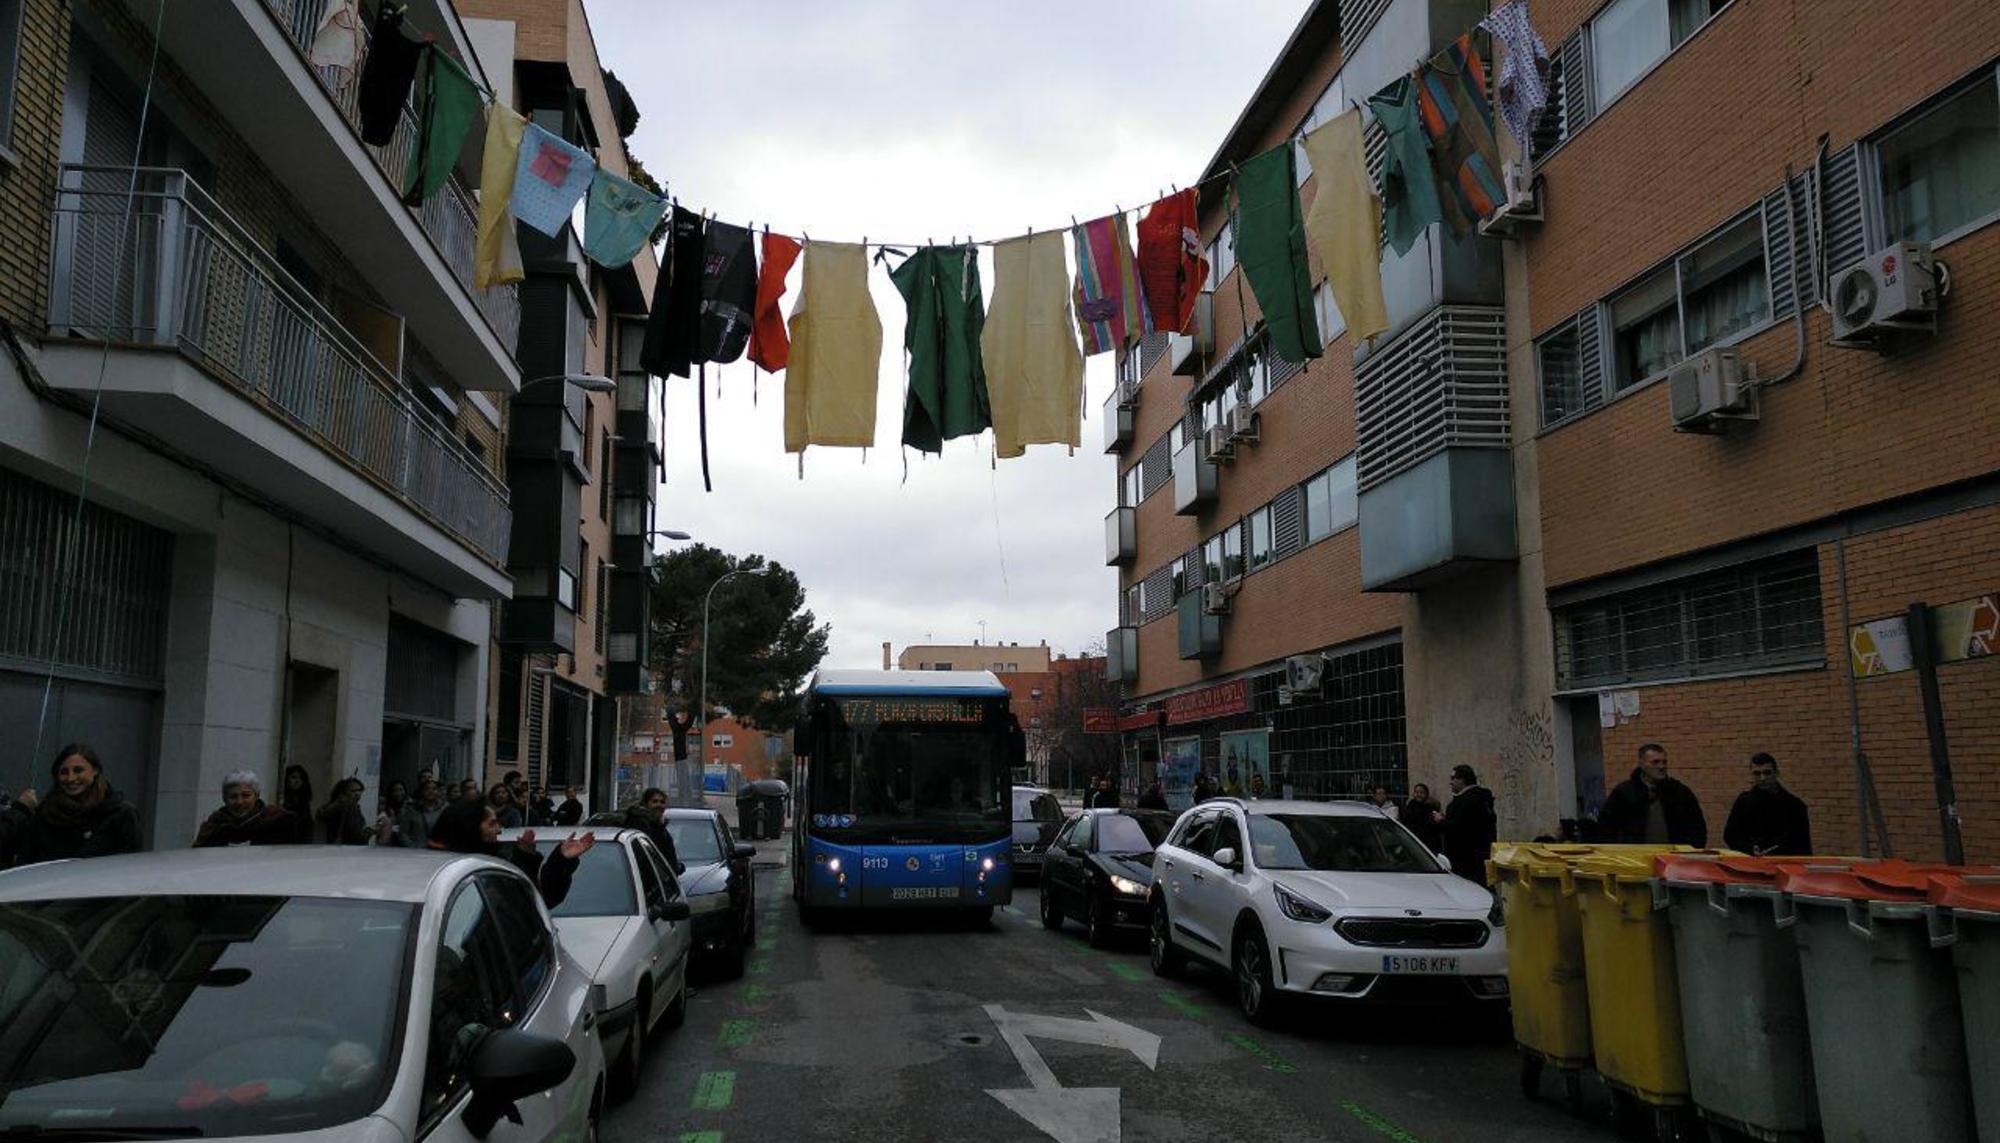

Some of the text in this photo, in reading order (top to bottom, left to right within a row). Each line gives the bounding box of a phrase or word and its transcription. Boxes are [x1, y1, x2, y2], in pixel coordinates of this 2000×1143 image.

[863, 857, 889, 869] 9113
[1393, 957, 1457, 971] 5106 KFV
